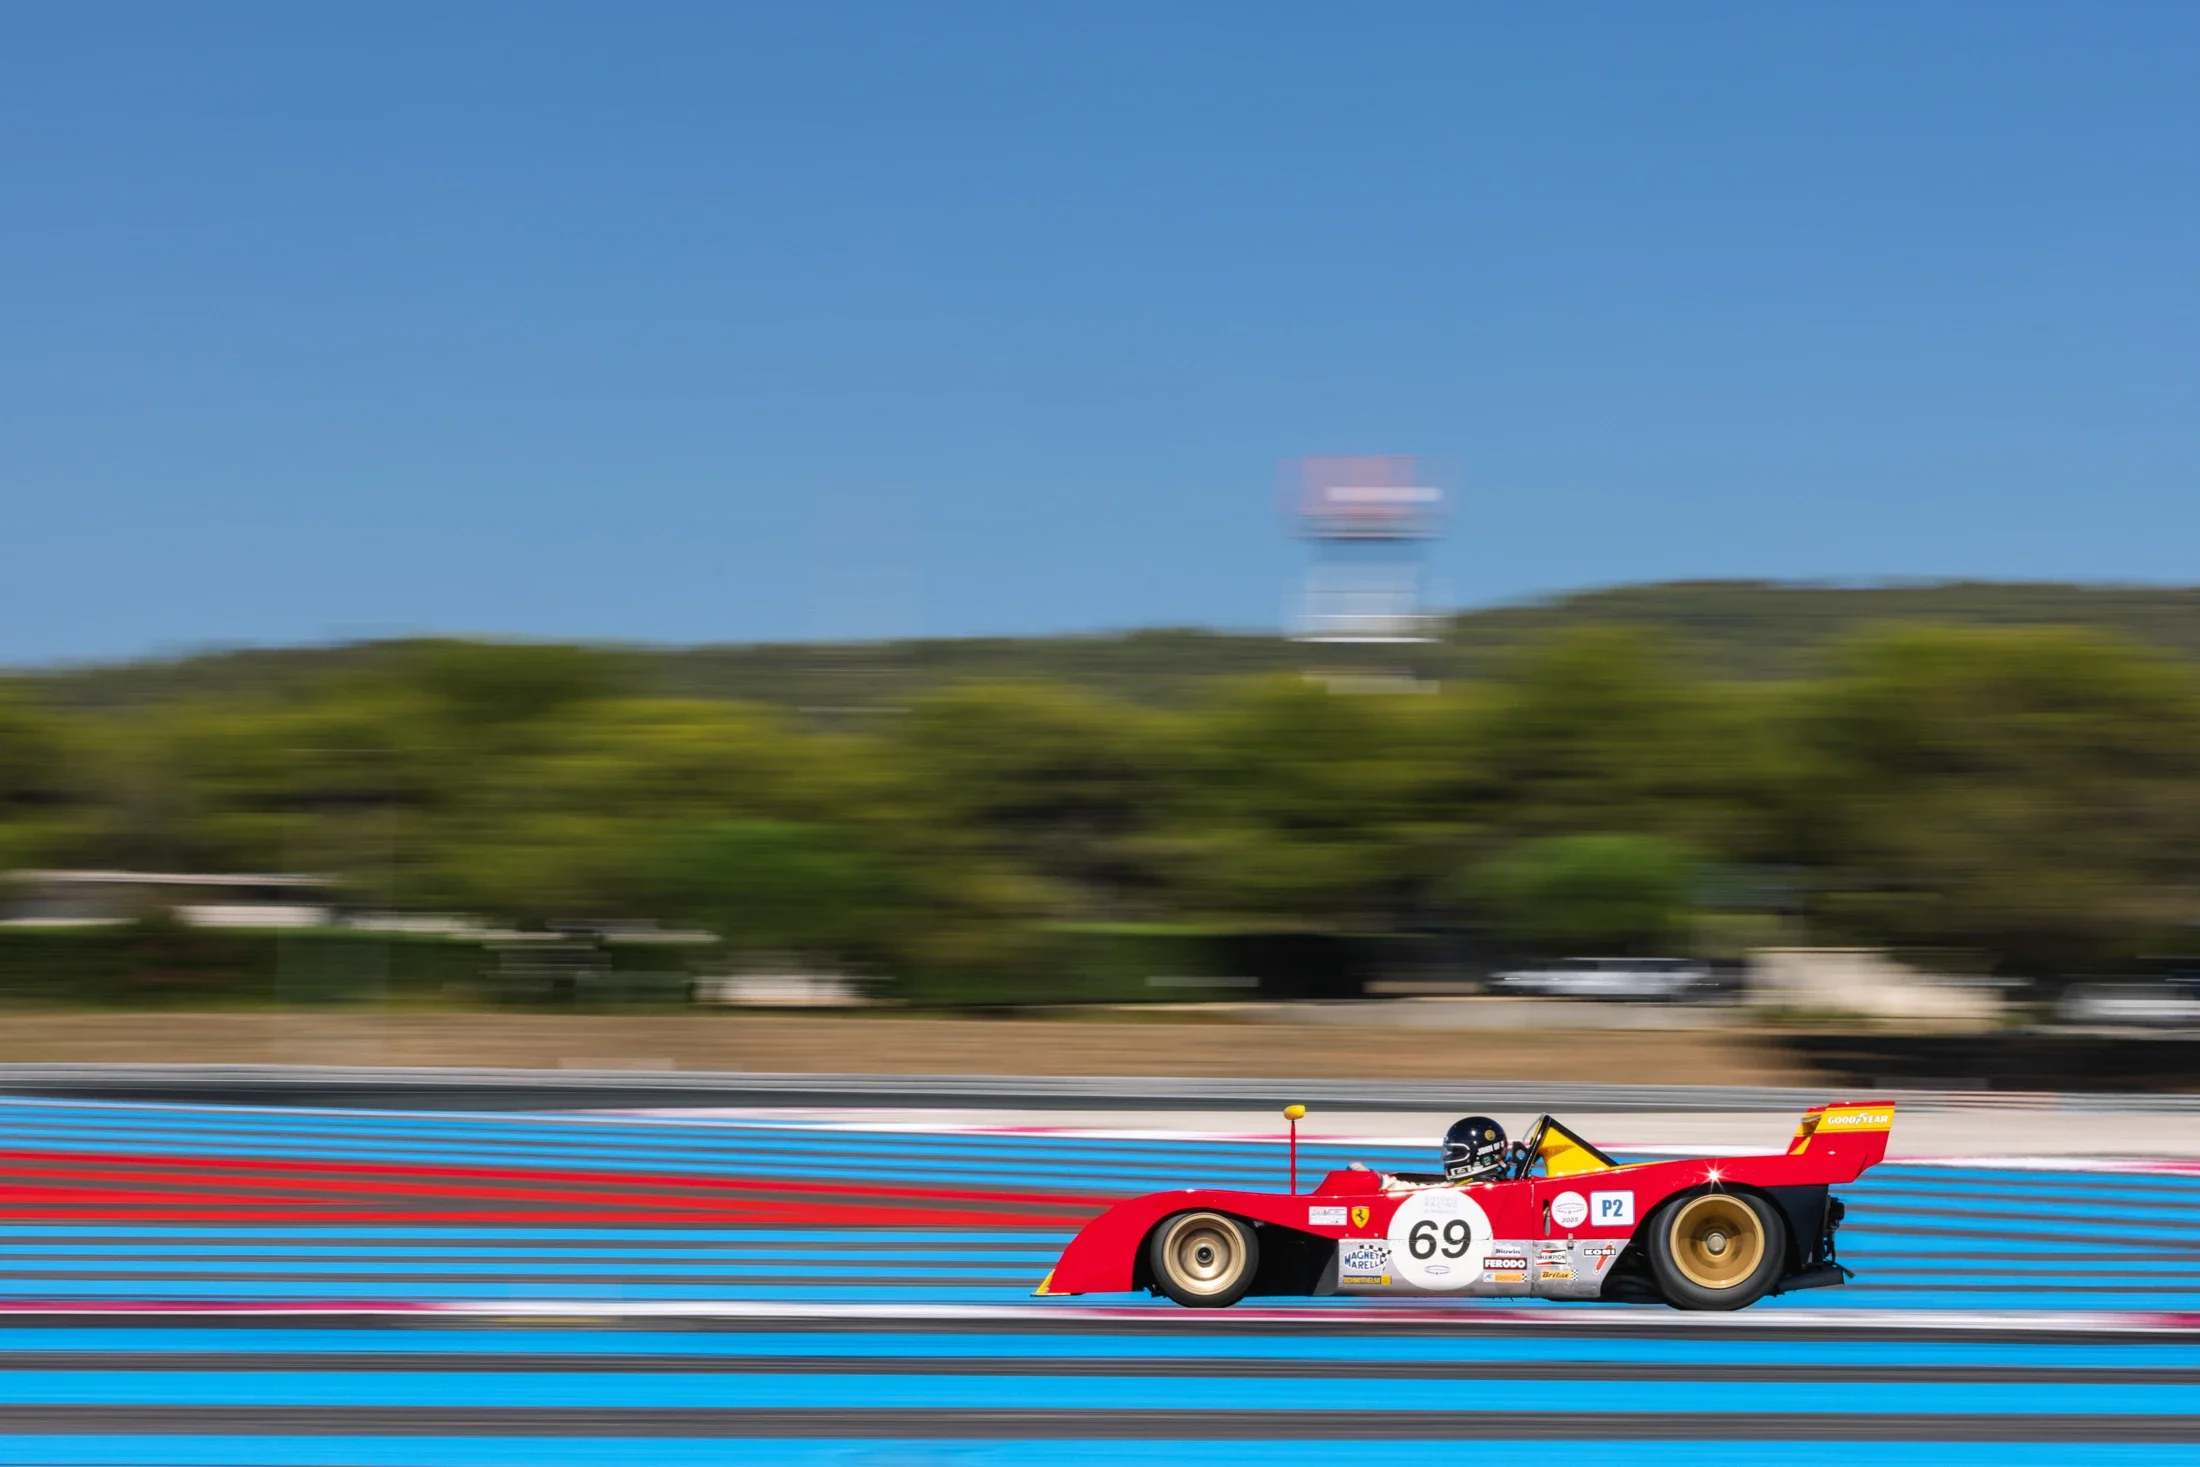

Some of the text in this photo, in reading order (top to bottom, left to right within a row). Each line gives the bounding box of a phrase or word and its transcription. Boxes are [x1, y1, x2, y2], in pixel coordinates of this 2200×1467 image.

[1828, 1113, 1888, 1125] GOODYEAR
[1602, 1199, 1623, 1217] P2
[1408, 1219, 1472, 1260] 69
[1485, 1259, 1525, 1268] FERODO
[1542, 1271, 1569, 1279] Britax
